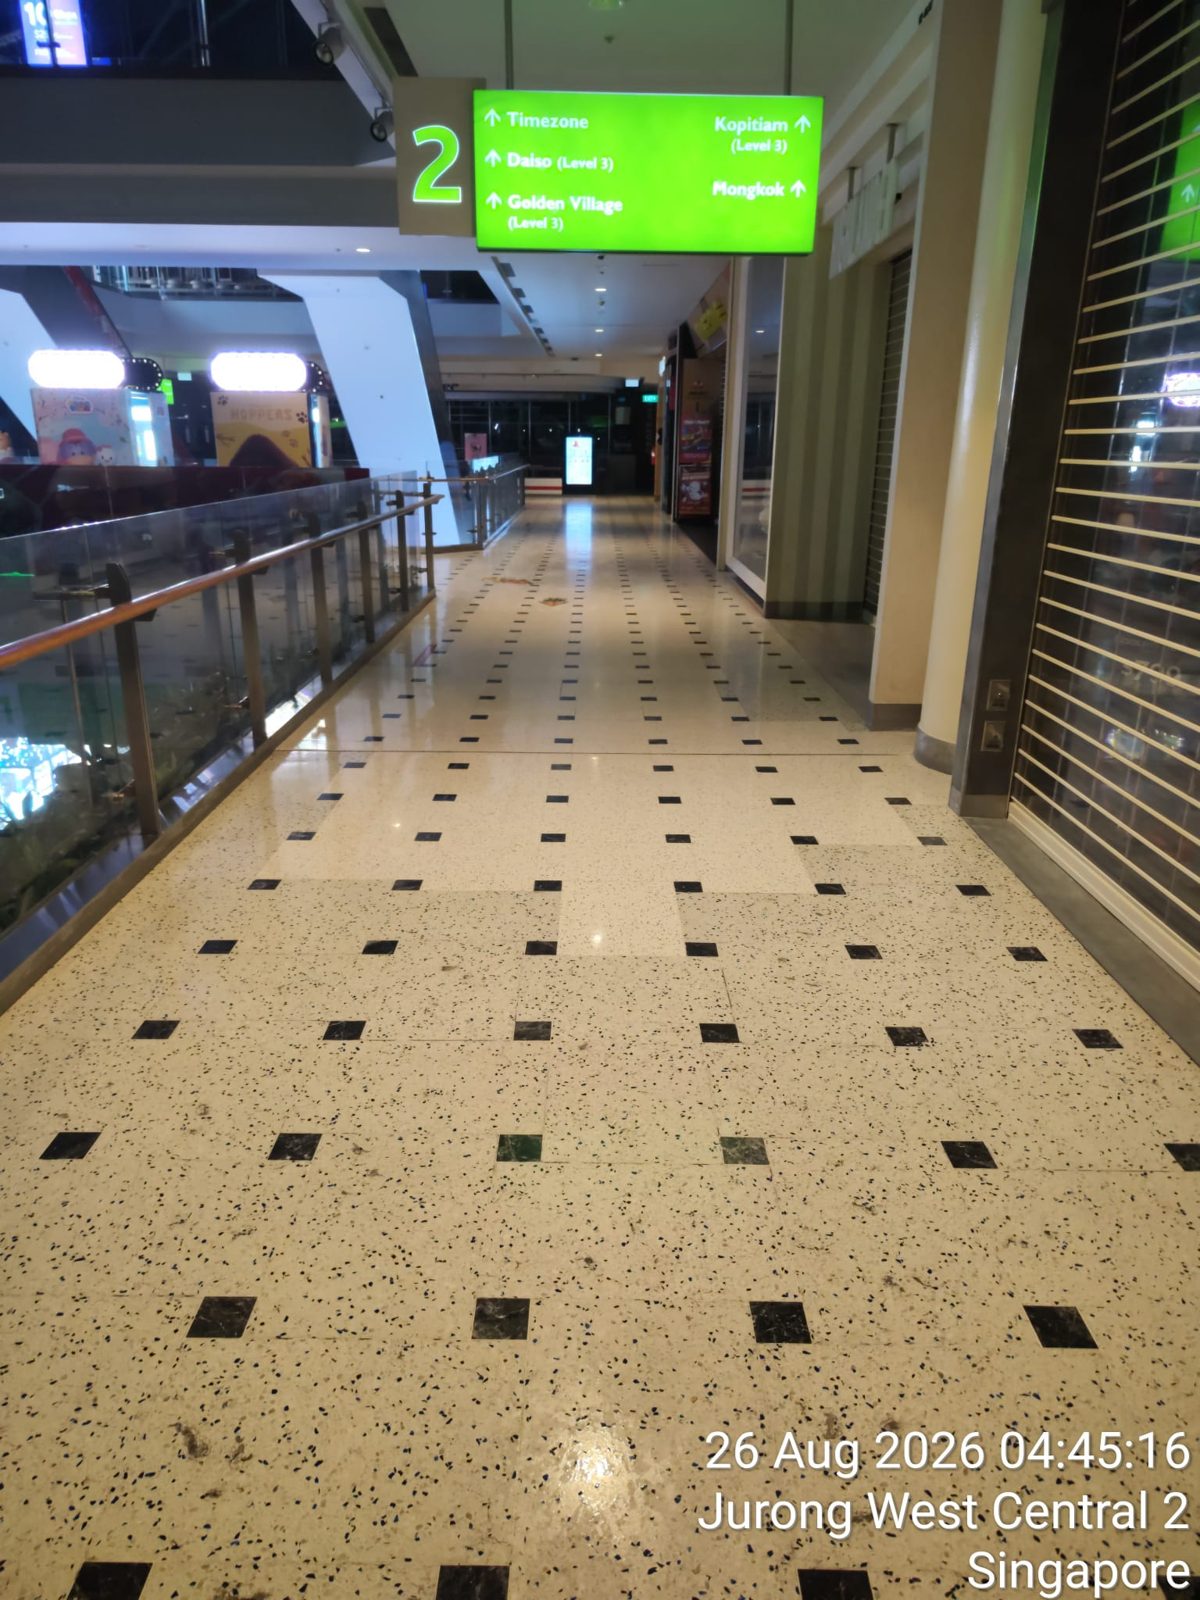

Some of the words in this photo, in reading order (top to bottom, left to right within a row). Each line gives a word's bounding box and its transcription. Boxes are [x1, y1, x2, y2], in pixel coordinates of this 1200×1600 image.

[507, 111, 589, 130] Timezone
[714, 116, 788, 136] Kopitiam
[730, 138, 771, 155] (Level
[774, 139, 788, 155] 3)
[412, 124, 463, 204] 2
[507, 151, 553, 169] Daiso
[556, 156, 595, 171] (Level
[598, 157, 614, 173] 3)
[712, 181, 785, 200] Mongkok
[507, 194, 566, 212] Golden
[569, 195, 624, 216] Village
[507, 216, 548, 231] (Level
[551, 217, 564, 232] 3)
